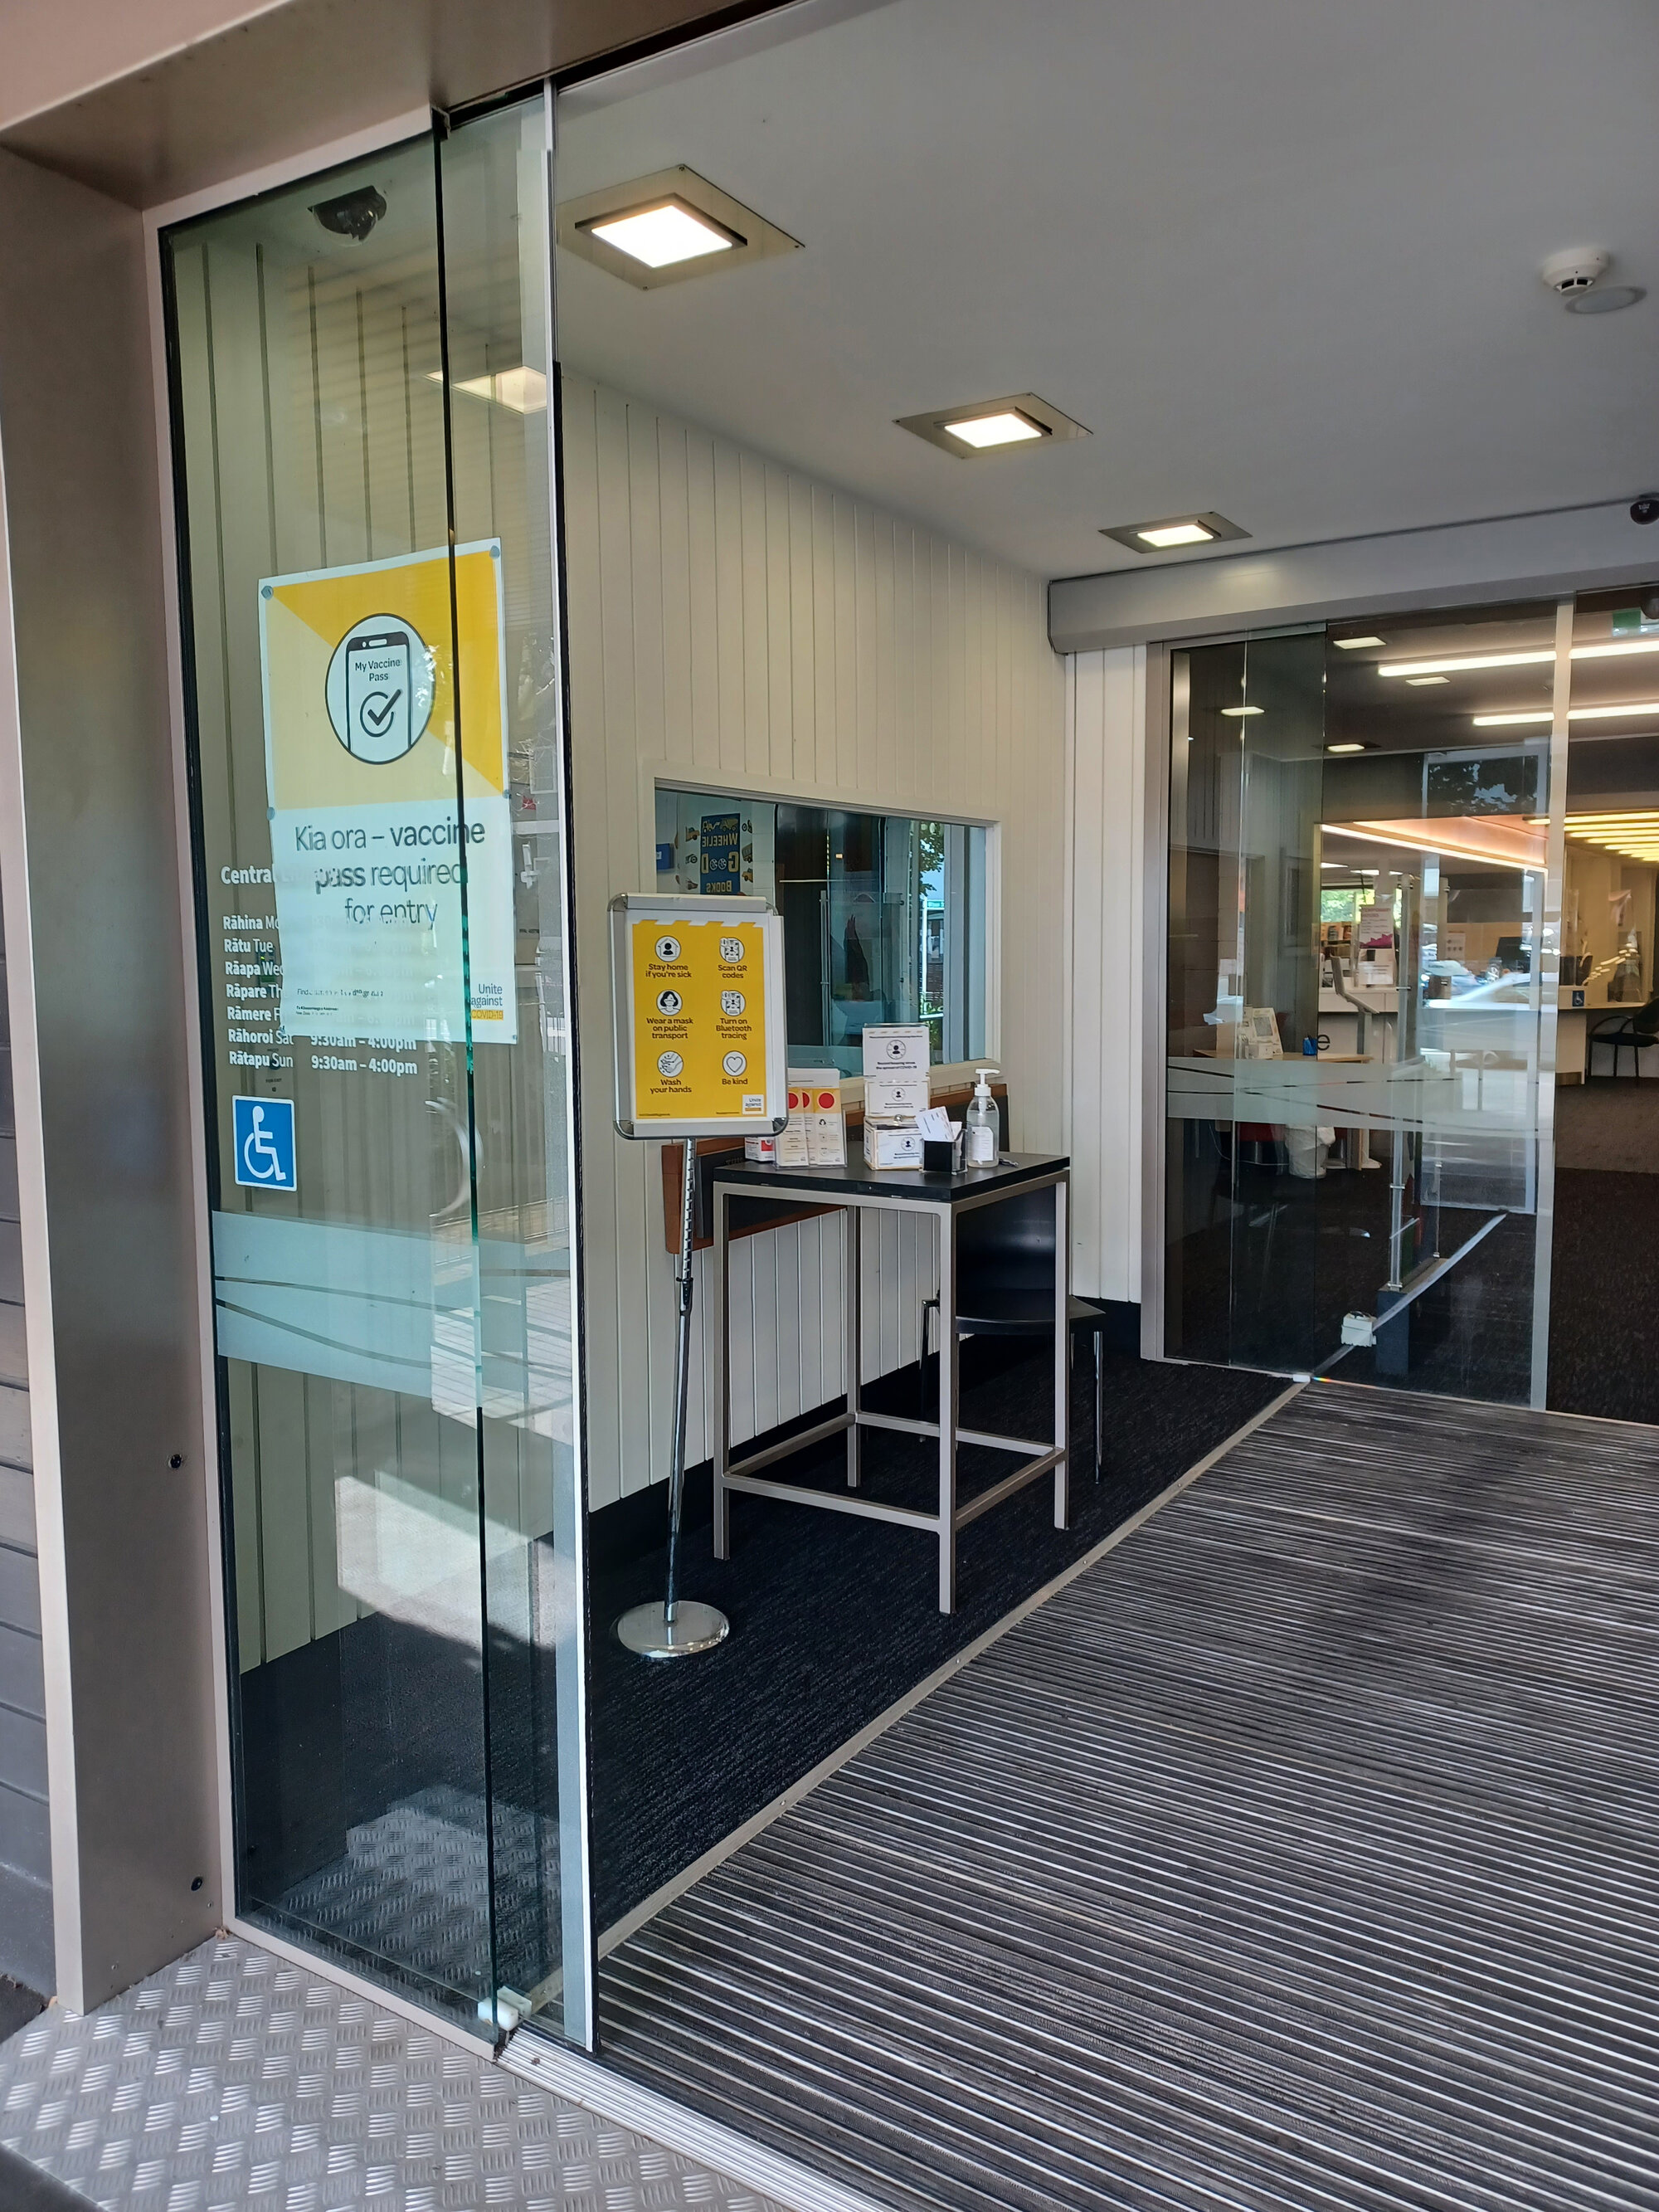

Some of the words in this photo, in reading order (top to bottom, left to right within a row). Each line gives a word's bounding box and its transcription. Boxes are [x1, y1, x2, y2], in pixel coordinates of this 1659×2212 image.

[355, 661, 367, 673] My
[367, 658, 401, 670] Vaccine
[369, 672, 389, 682] Pass
[295, 824, 326, 851] Kia
[332, 829, 366, 850] ora
[390, 816, 485, 846] vaccine
[314, 866, 366, 894] pass
[345, 898, 374, 924] for
[380, 899, 437, 930] entry
[222, 914, 263, 930] Rāhina
[265, 915, 280, 929] Mo
[224, 938, 251, 953] Rātu
[252, 938, 274, 953] Tue
[225, 961, 260, 978] Rāapa
[648, 963, 666, 972] Stay
[651, 971, 676, 979] you're
[226, 983, 267, 1001] Rāpare
[478, 982, 503, 995] Unite
[470, 995, 504, 1008] against
[226, 1006, 272, 1021] Rāmere
[470, 1009, 504, 1021] COVID-19
[228, 1028, 274, 1044] Rāhoroi
[664, 1025, 688, 1033] public
[721, 1032, 747, 1040] tracing
[229, 1050, 270, 1069] Rātapu
[271, 1052, 294, 1068] Sun
[311, 1055, 358, 1071] 9:30am
[368, 1057, 418, 1077] 4:00pm
[649, 1087, 668, 1095] your
